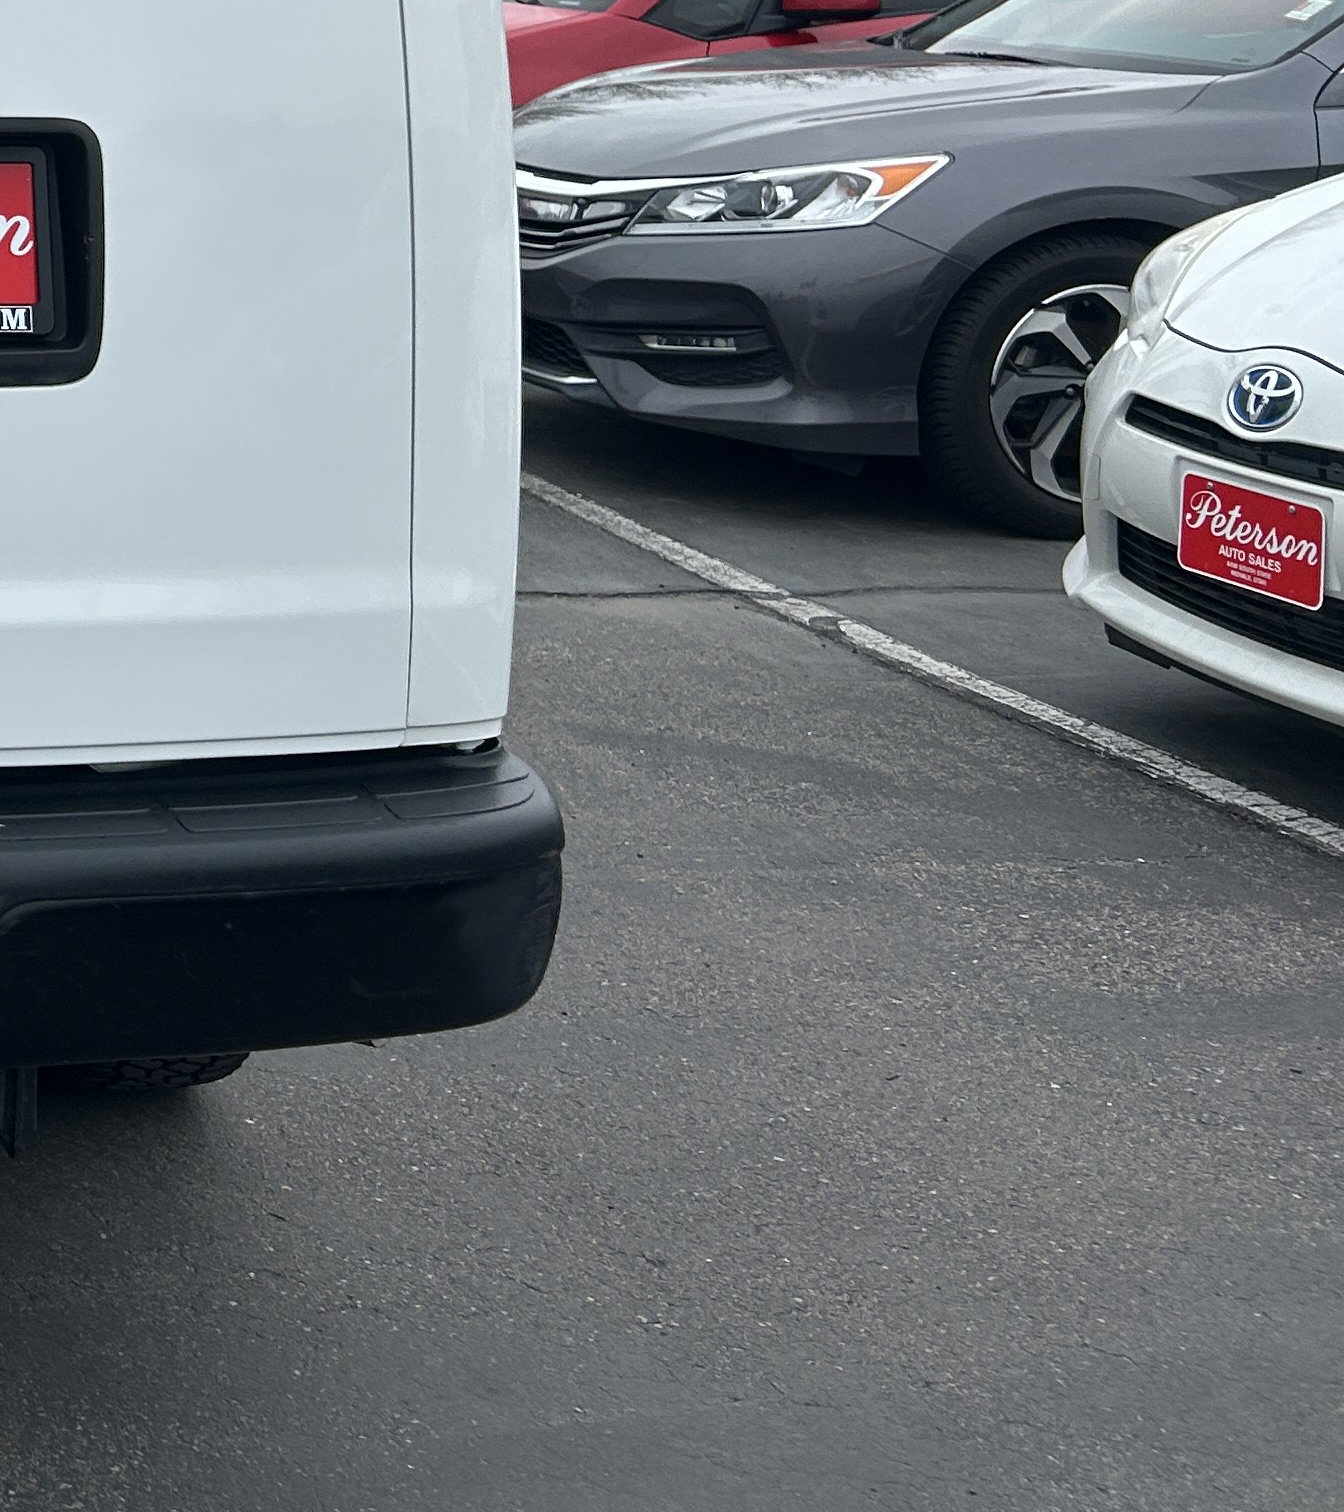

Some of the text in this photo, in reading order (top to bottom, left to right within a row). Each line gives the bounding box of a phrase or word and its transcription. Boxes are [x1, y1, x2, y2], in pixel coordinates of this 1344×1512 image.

[1185, 490, 1318, 566] Peterson
[1218, 544, 1246, 562] AUTO
[1248, 552, 1282, 573] SALES
